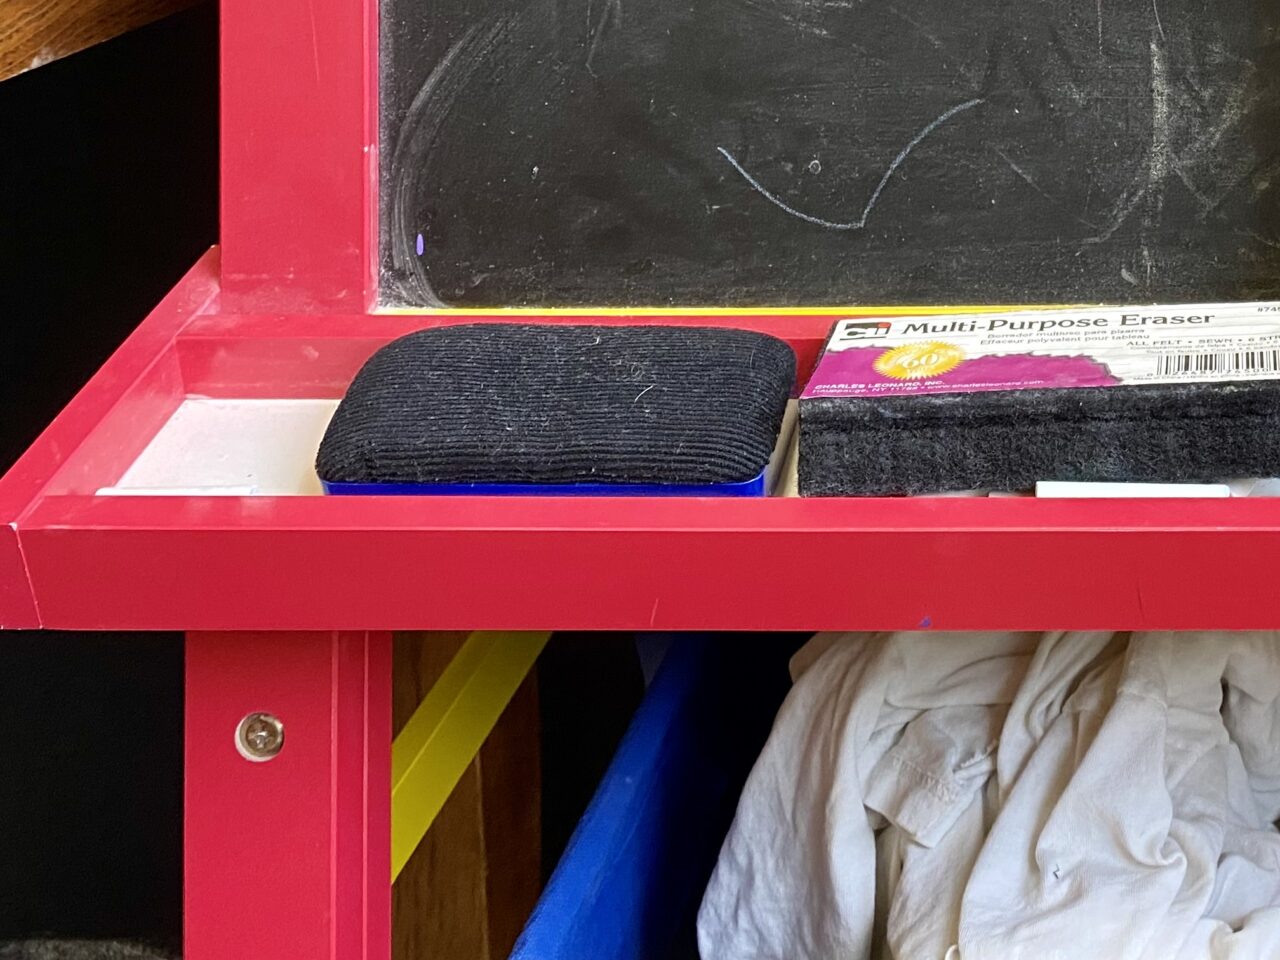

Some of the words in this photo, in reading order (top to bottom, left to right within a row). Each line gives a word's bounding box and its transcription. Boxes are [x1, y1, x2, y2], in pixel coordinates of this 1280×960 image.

[902, 318, 1108, 334] Multi-Purpose
[1120, 313, 1216, 326] Eraser
[814, 382, 866, 390] CHARLES
